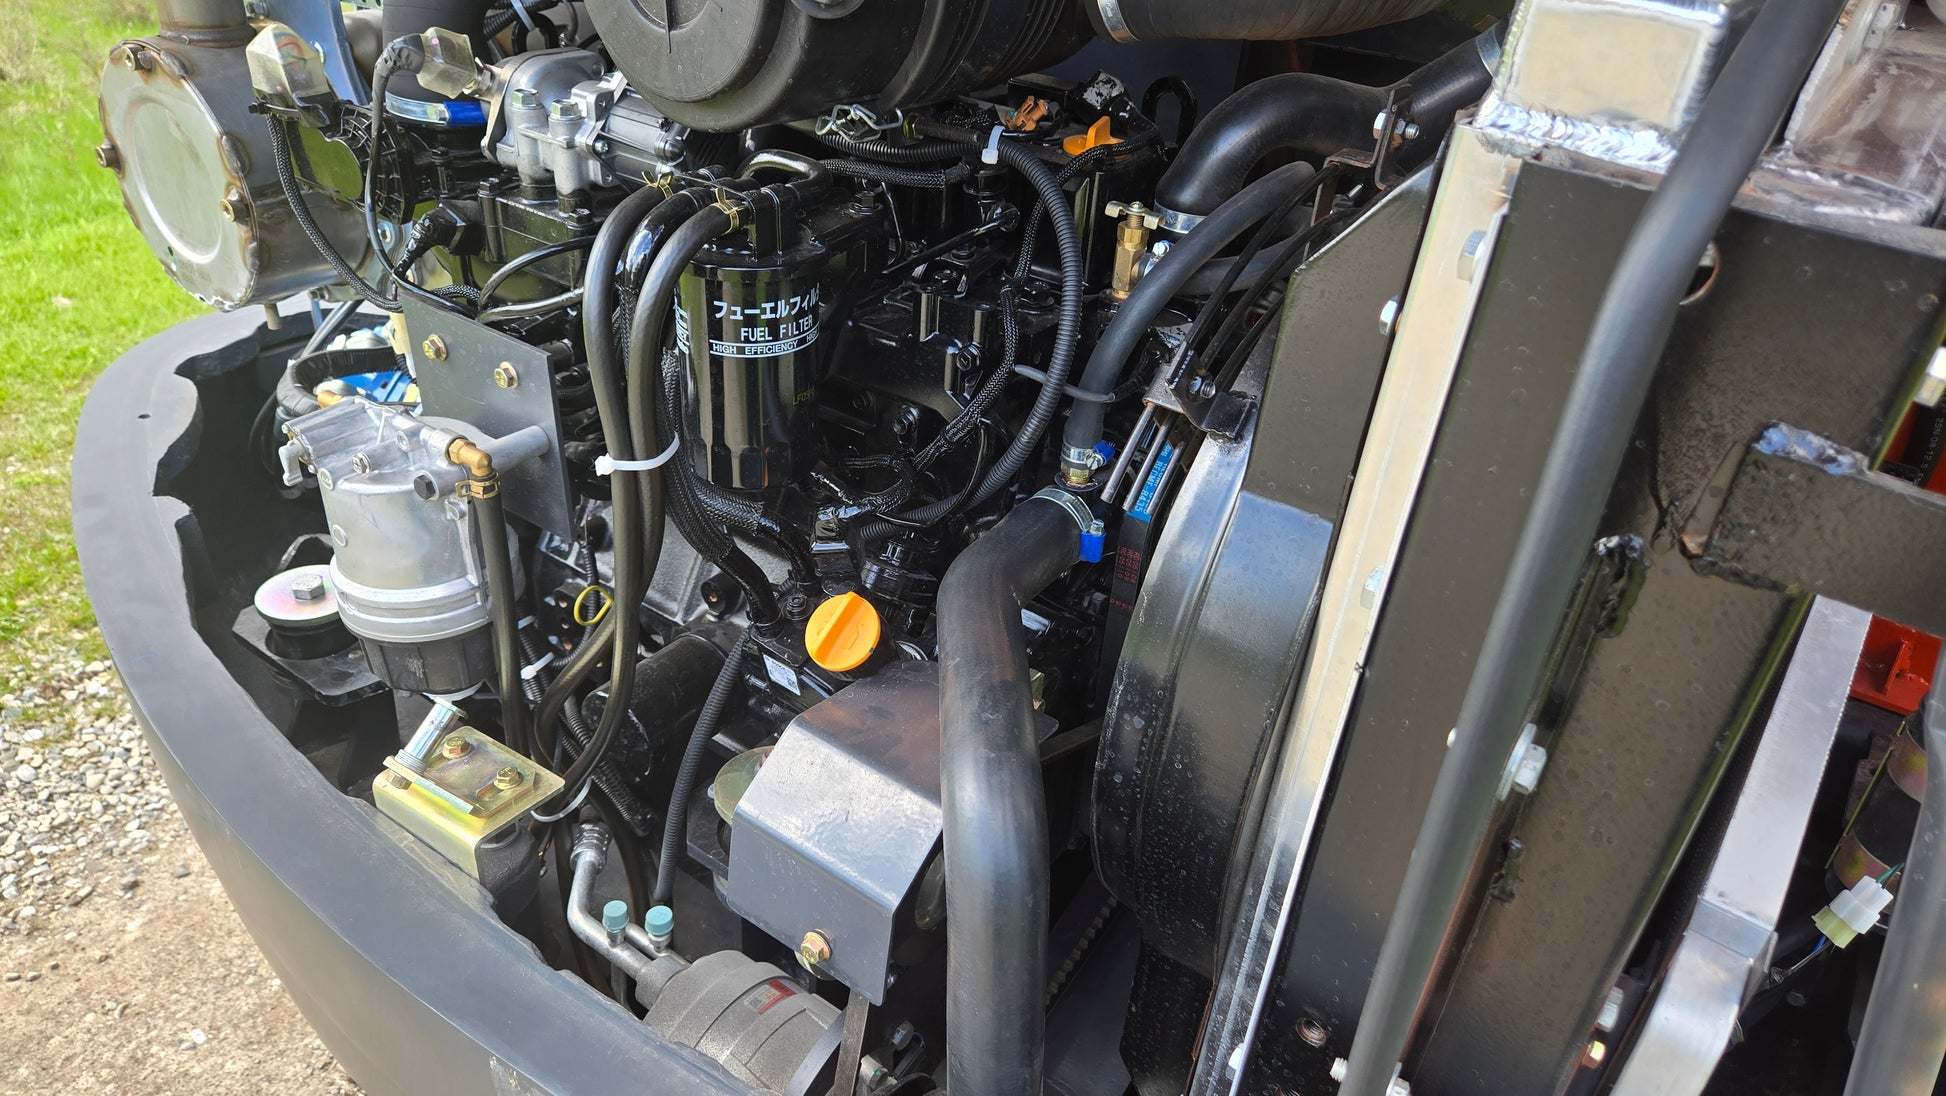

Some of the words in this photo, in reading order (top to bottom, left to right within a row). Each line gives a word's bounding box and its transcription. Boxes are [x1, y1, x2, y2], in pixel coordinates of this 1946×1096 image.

[740, 326, 773, 342] FUEL
[779, 314, 813, 339] FILTER
[712, 343, 737, 354] HIGH
[745, 340, 799, 355] EFFICIENCY
